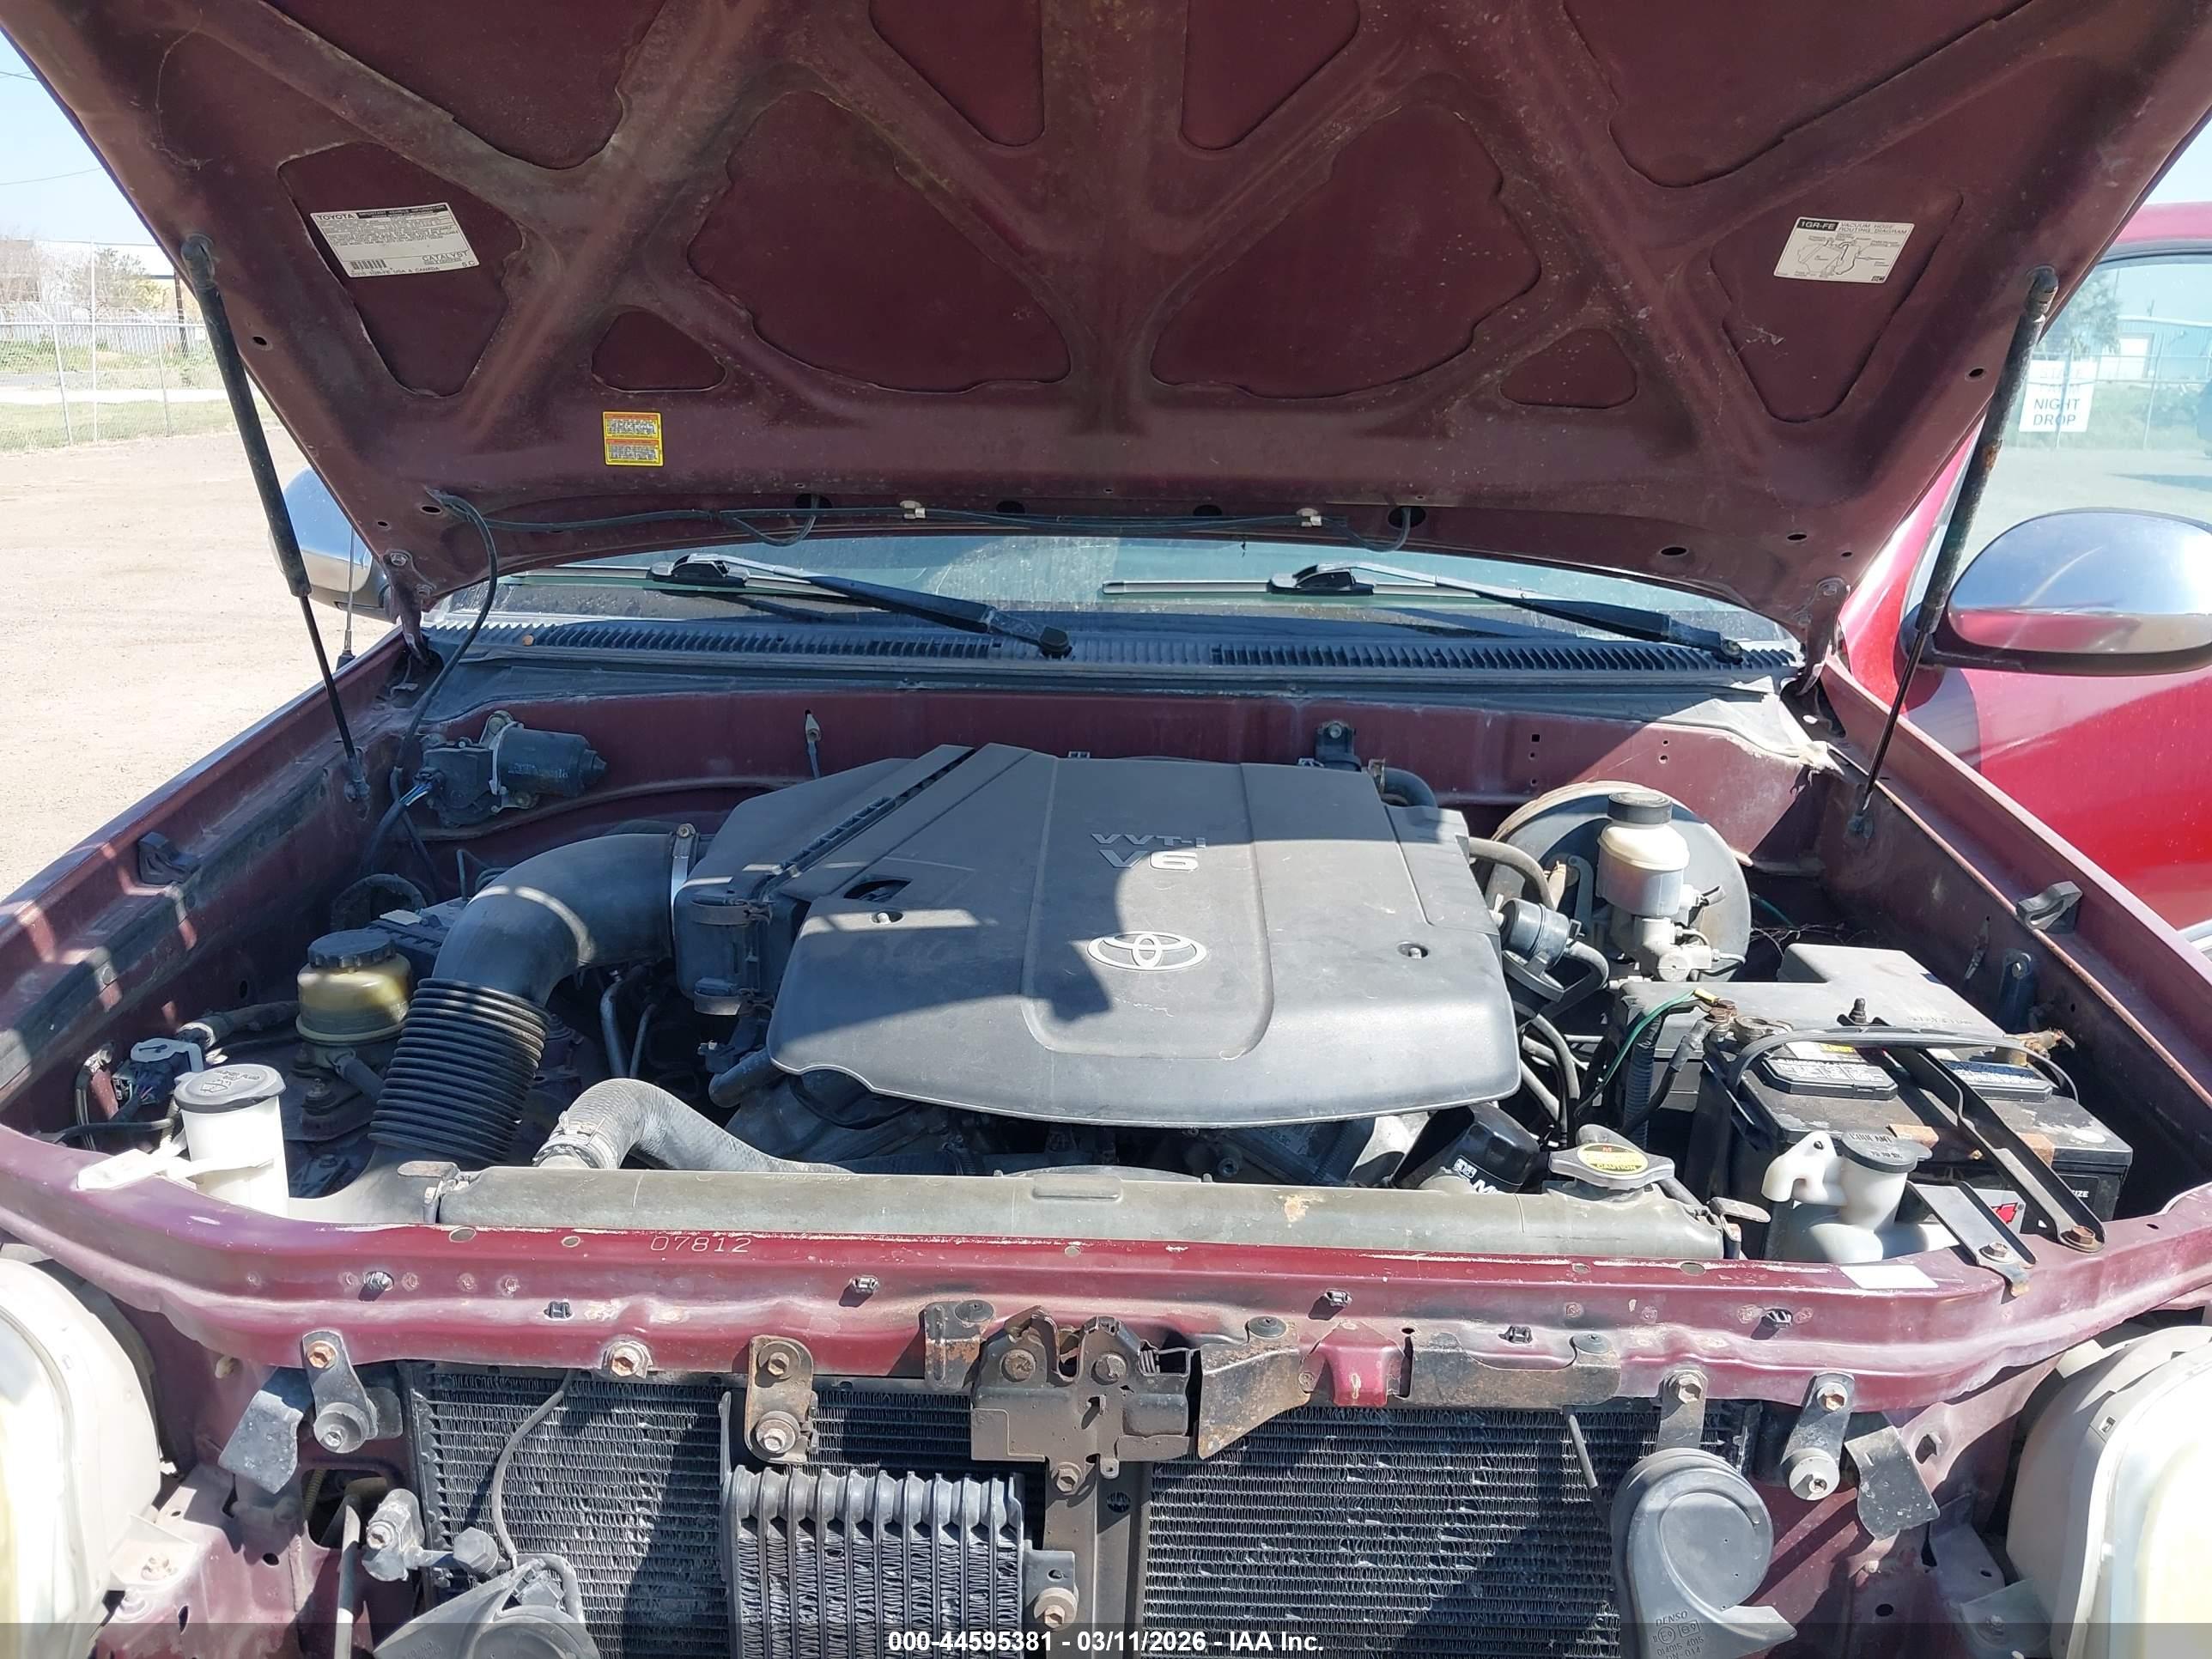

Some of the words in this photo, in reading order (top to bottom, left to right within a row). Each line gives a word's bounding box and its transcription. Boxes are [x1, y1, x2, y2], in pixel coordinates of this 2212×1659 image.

[1800, 221, 1835, 230] 1GR-FE
[422, 250, 469, 262] CATALYST
[2039, 368, 2082, 379] STAE
[2033, 398, 2081, 410] NIGHT
[2033, 414, 2076, 426] DROP
[1098, 849, 1200, 872] V6
[650, 1236, 752, 1253] 07812
[1656, 1610, 1688, 1626] DENSO
